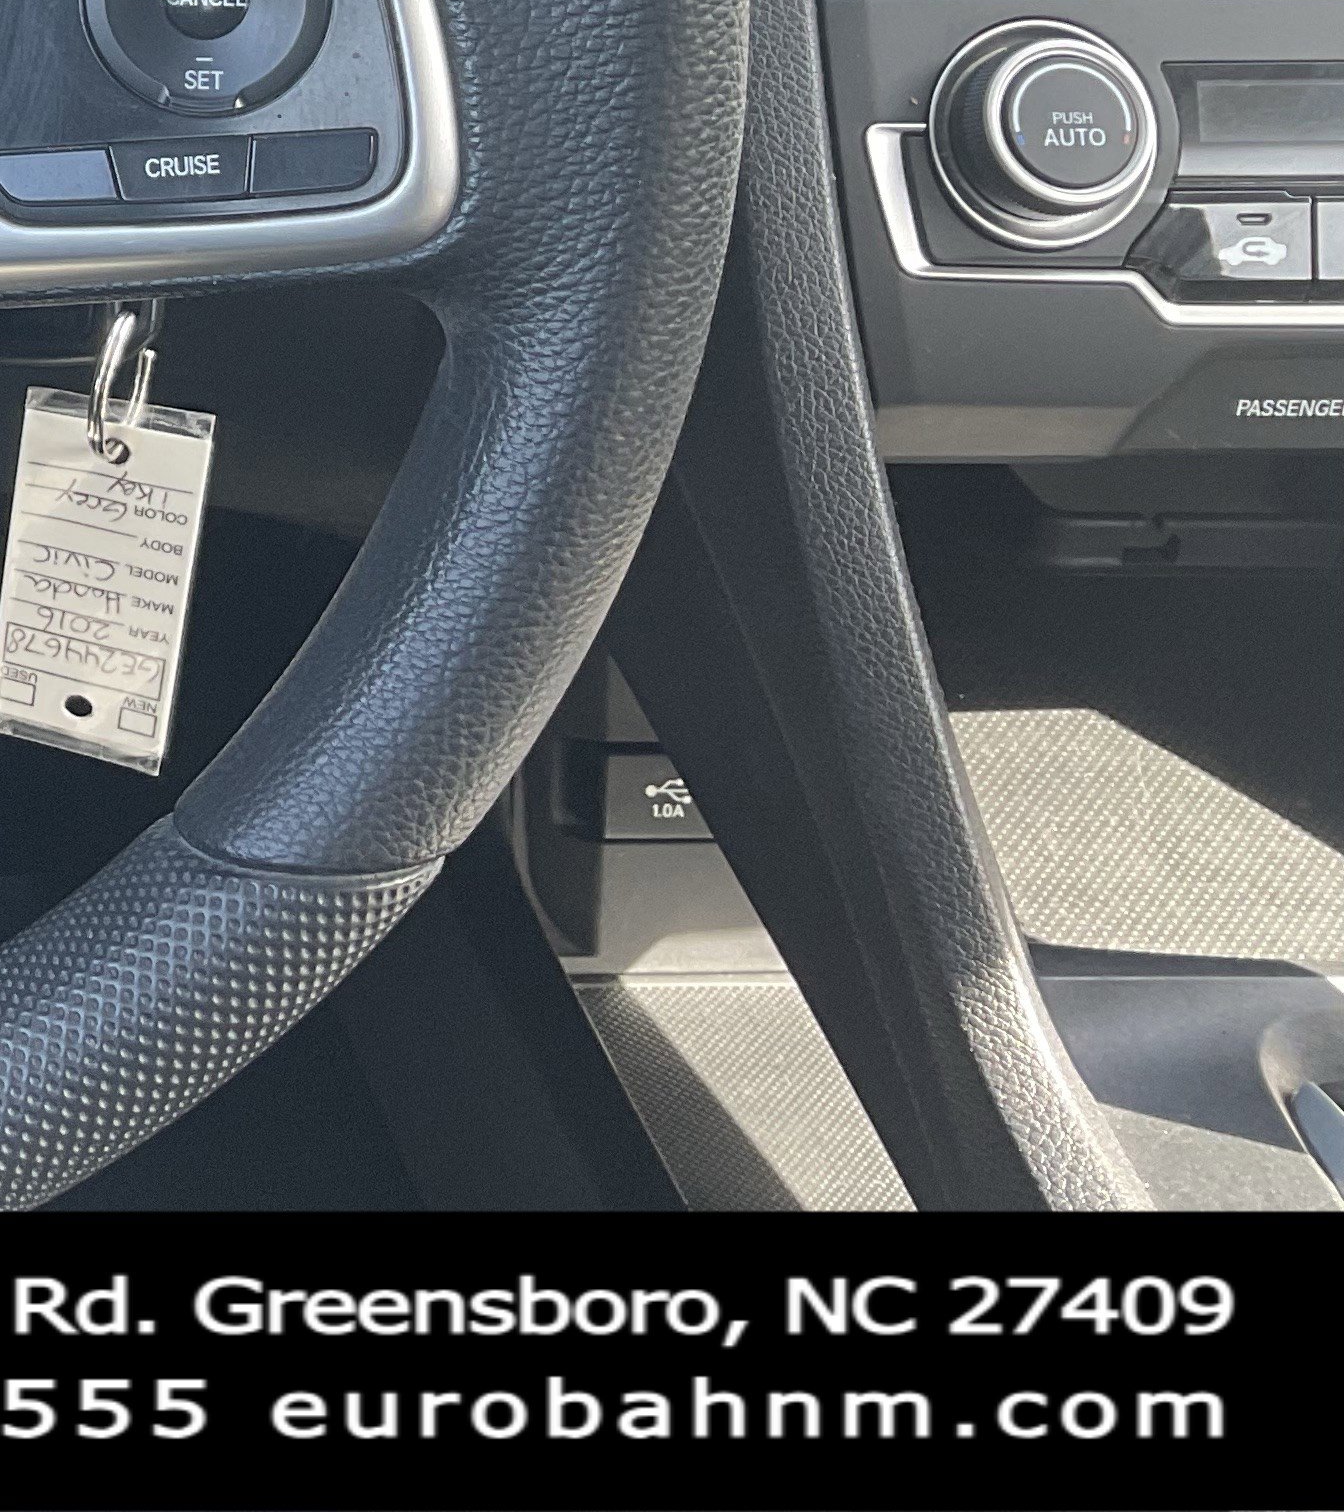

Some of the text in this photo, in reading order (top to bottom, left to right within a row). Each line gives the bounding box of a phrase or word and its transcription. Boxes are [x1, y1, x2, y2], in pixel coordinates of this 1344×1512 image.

[183, 69, 224, 91] SET
[1051, 110, 1094, 126] PUSH
[1043, 127, 1107, 148] AUTO
[144, 153, 221, 178] CRUISE
[1235, 398, 1344, 418] PASSENGE
[133, 504, 189, 527] COLOR
[139, 537, 184, 557] BODY
[124, 564, 179, 587] MODEL
[23, 574, 175, 616] MAKE Honda
[35, 604, 170, 645] YEAR 2016
[0, 665, 39, 684] USED
[121, 696, 158, 714] NEW
